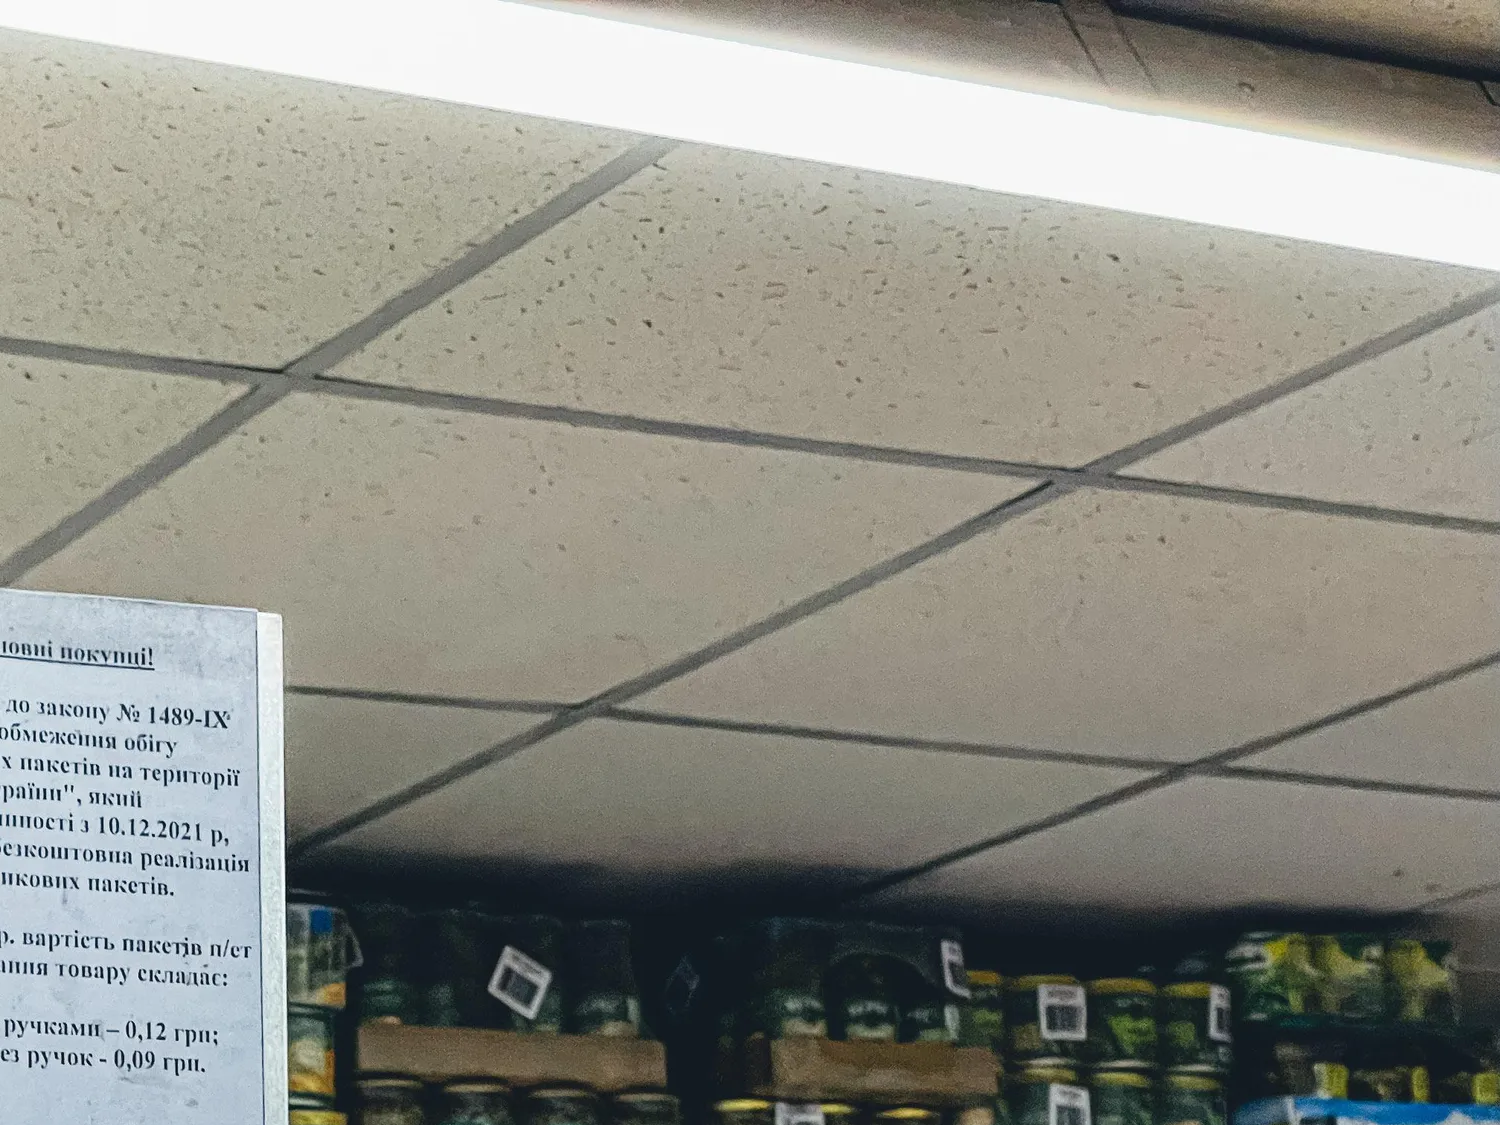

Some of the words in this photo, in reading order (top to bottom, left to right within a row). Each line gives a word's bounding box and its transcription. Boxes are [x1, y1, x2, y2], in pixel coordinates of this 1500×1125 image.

[60, 646, 154, 667] покупці!
[5, 699, 30, 713] до
[36, 702, 110, 724] закону
[117, 703, 140, 723] №
[149, 706, 229, 729] 1489-IX
[124, 734, 177, 758] обігу
[20, 757, 100, 776] пакетів
[108, 764, 133, 779] на
[140, 766, 241, 790] території
[88, 790, 142, 808] який
[80, 819, 89, 833] з
[99, 817, 202, 841] 10.12.2021
[140, 851, 250, 872] реалізація
[88, 876, 174, 896] пакетів.
[22, 930, 115, 952] вартість
[122, 937, 202, 956] пакетів
[55, 963, 130, 985] товару
[4, 1018, 100, 1038] ручками
[125, 1020, 167, 1042] 0,12
[174, 1028, 218, 1047] грн;
[27, 1049, 93, 1069] ручок
[114, 1049, 156, 1072] 0,09
[163, 1056, 206, 1076] грн.
